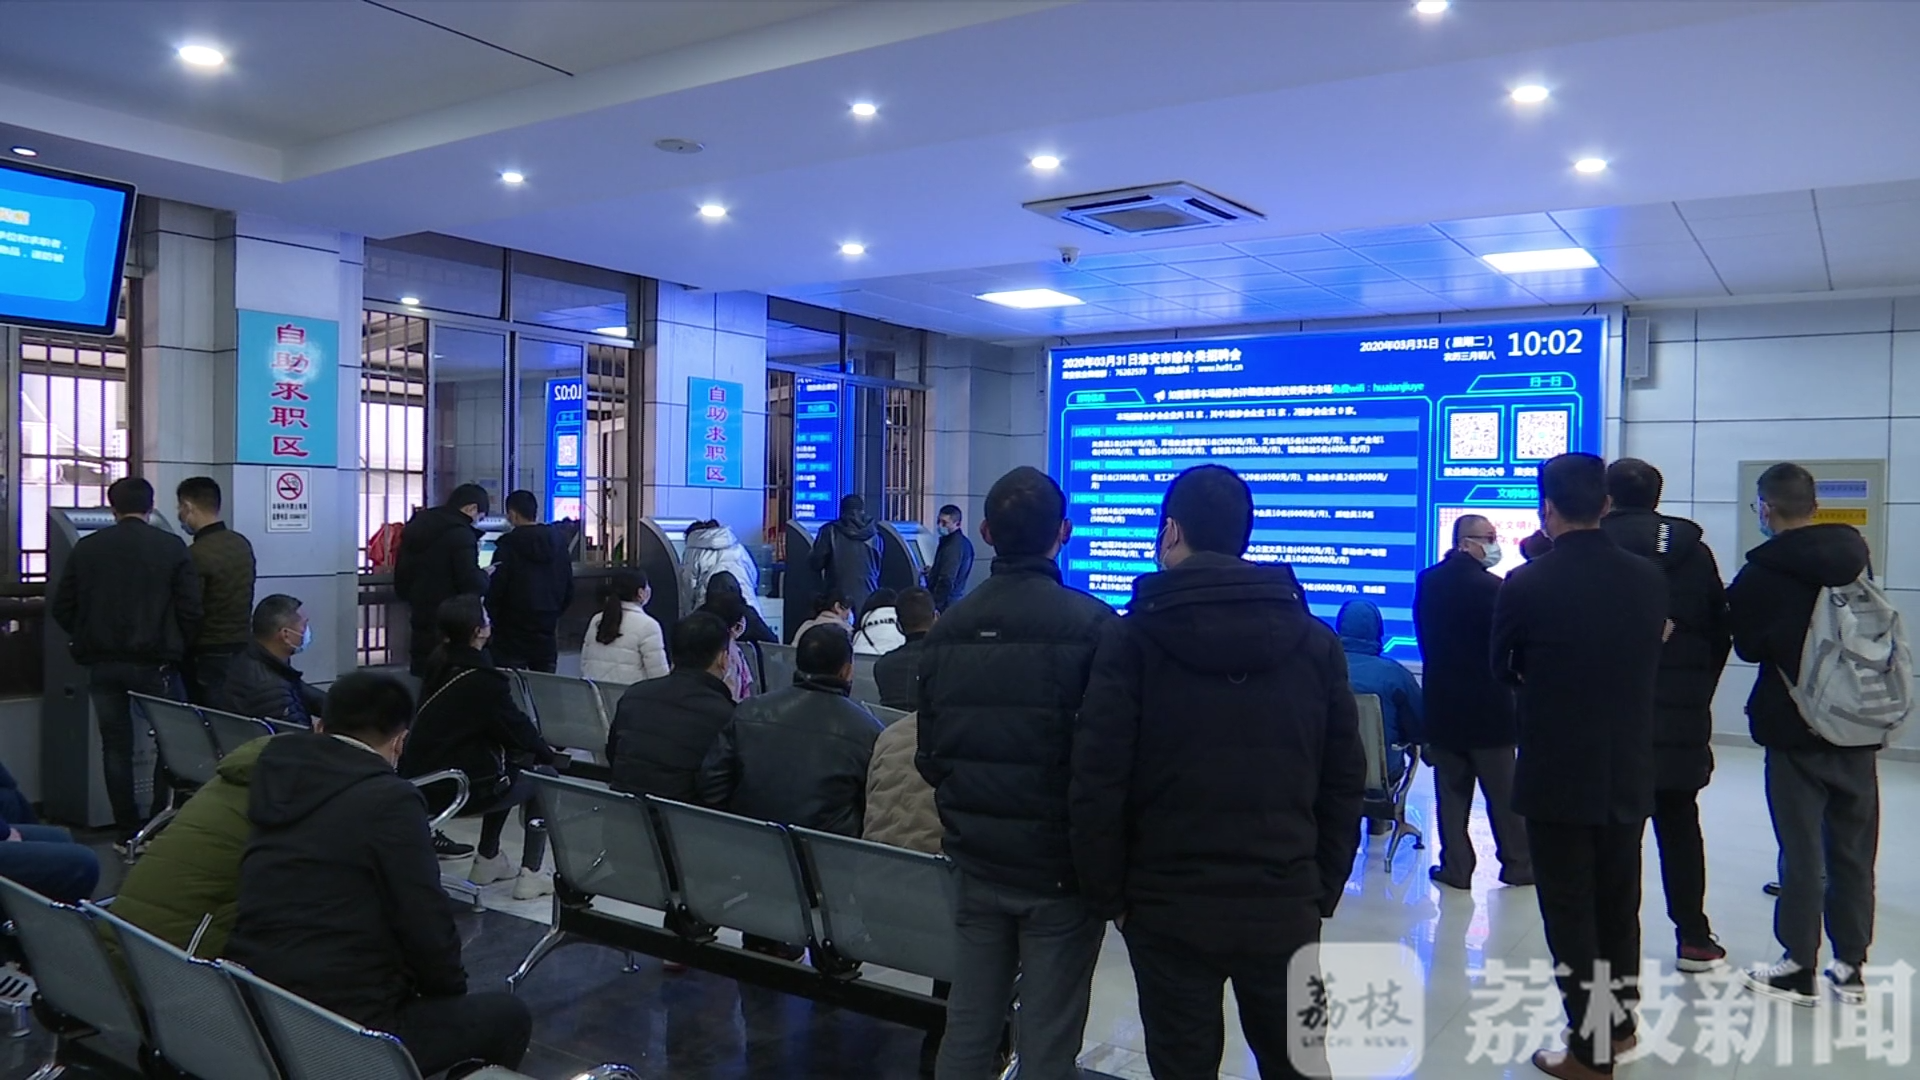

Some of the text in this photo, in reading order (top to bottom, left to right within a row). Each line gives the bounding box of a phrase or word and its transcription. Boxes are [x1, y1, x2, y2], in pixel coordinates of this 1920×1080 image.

[270, 324, 308, 457] 自助求职区
[1509, 329, 1582, 356] 10:02
[705, 386, 727, 482] 自助求职区
